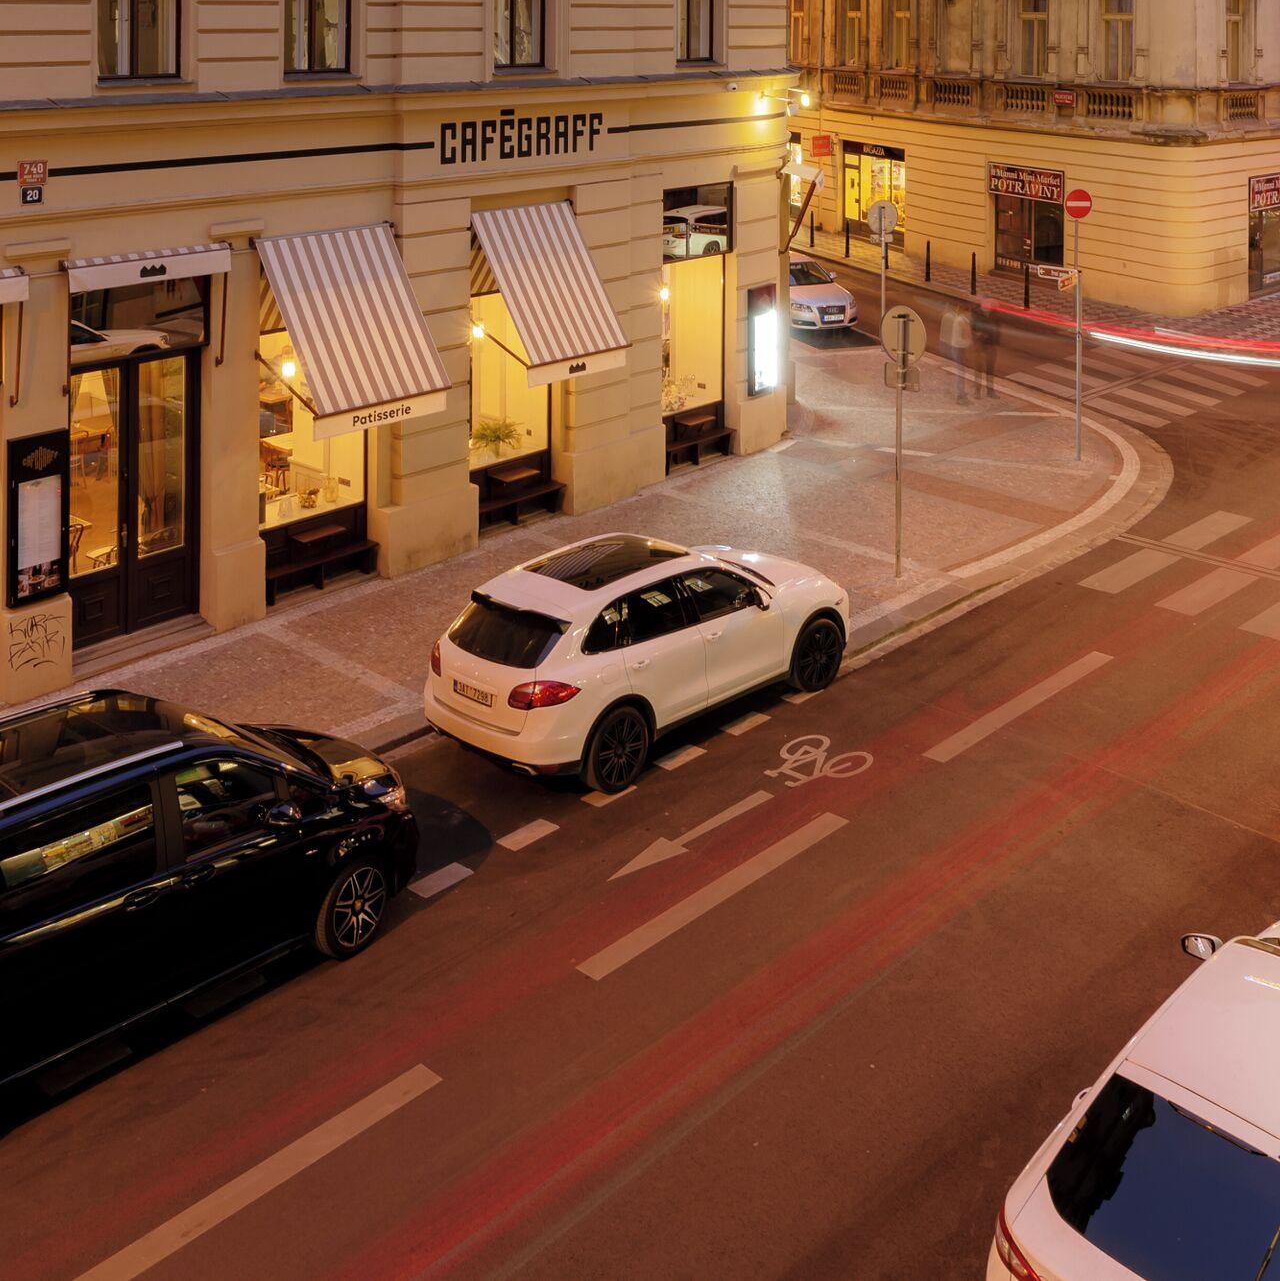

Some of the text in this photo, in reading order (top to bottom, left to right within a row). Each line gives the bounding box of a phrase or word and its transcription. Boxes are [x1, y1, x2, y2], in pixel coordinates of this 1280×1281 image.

[23, 163, 44, 174] 740
[26, 190, 39, 201] 20
[990, 177, 1061, 199] POTRAVINY
[352, 404, 412, 427] Patisserie
